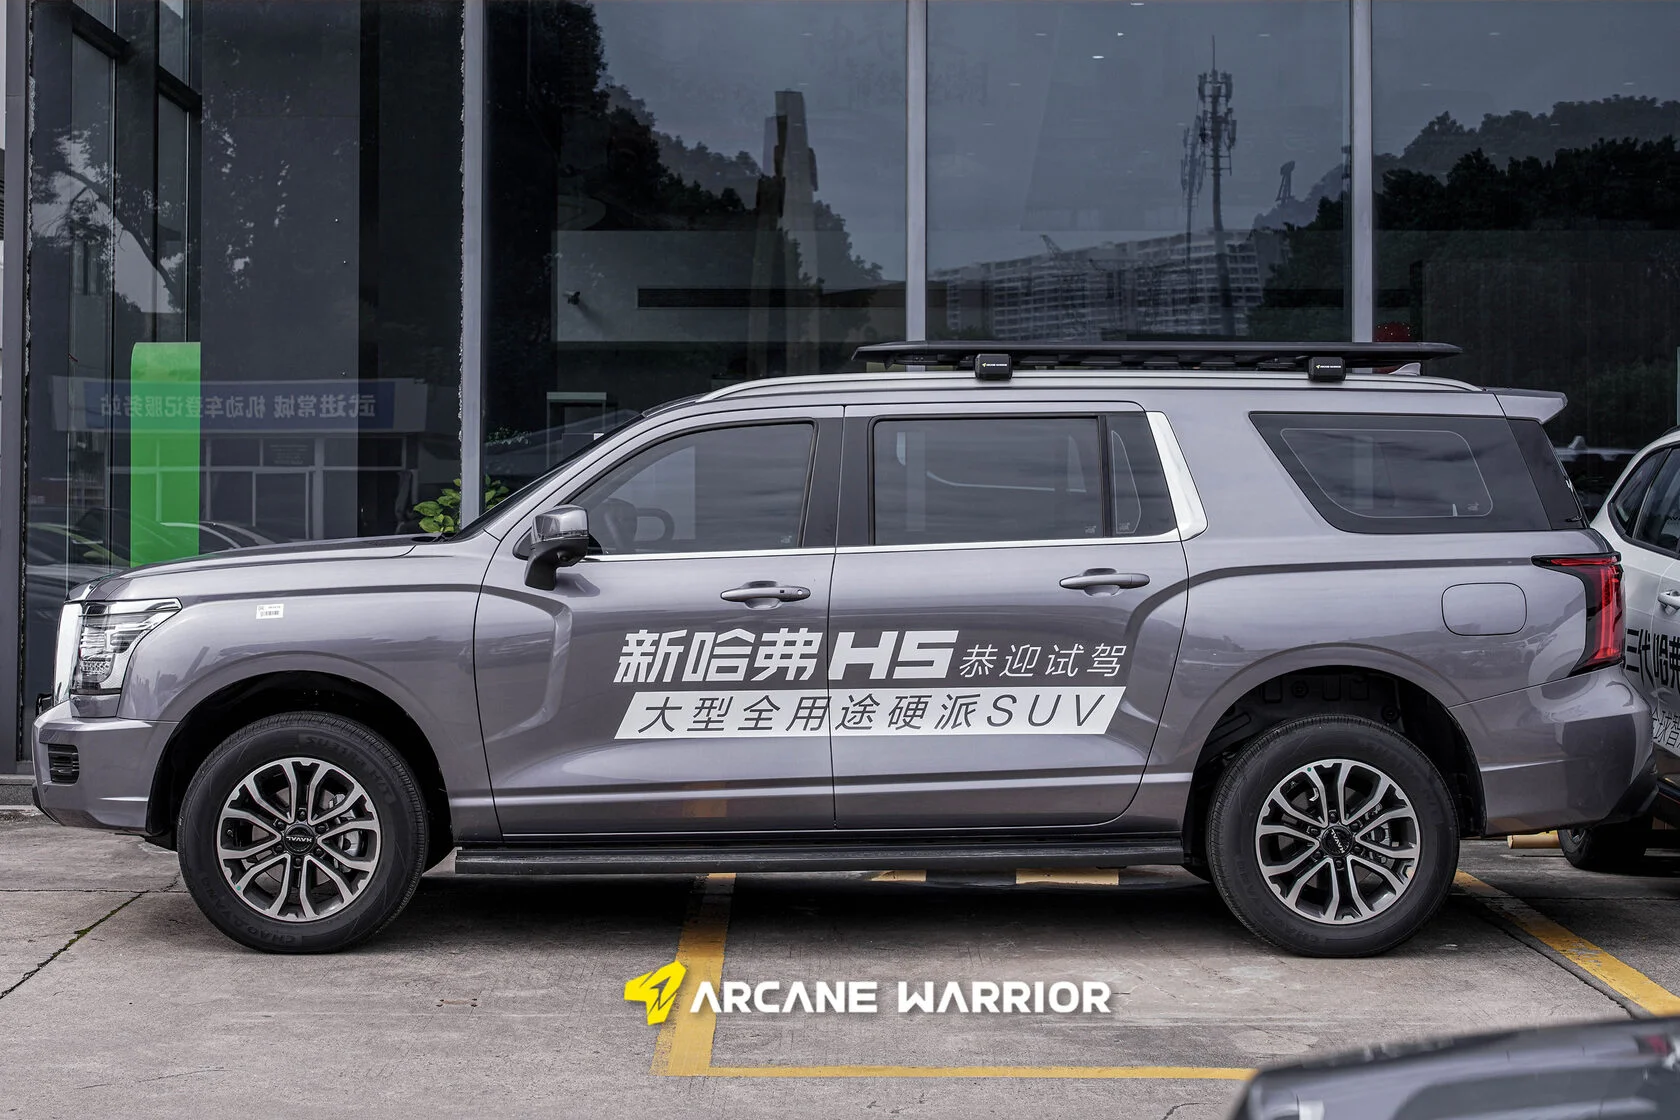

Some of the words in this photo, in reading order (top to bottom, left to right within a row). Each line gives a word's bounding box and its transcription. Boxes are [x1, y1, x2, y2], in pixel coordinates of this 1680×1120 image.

[613, 627, 959, 683] 新哈弗H5
[959, 643, 1127, 678] 恭迎试驾
[637, 693, 1106, 733] 大型全用途硬派SUV
